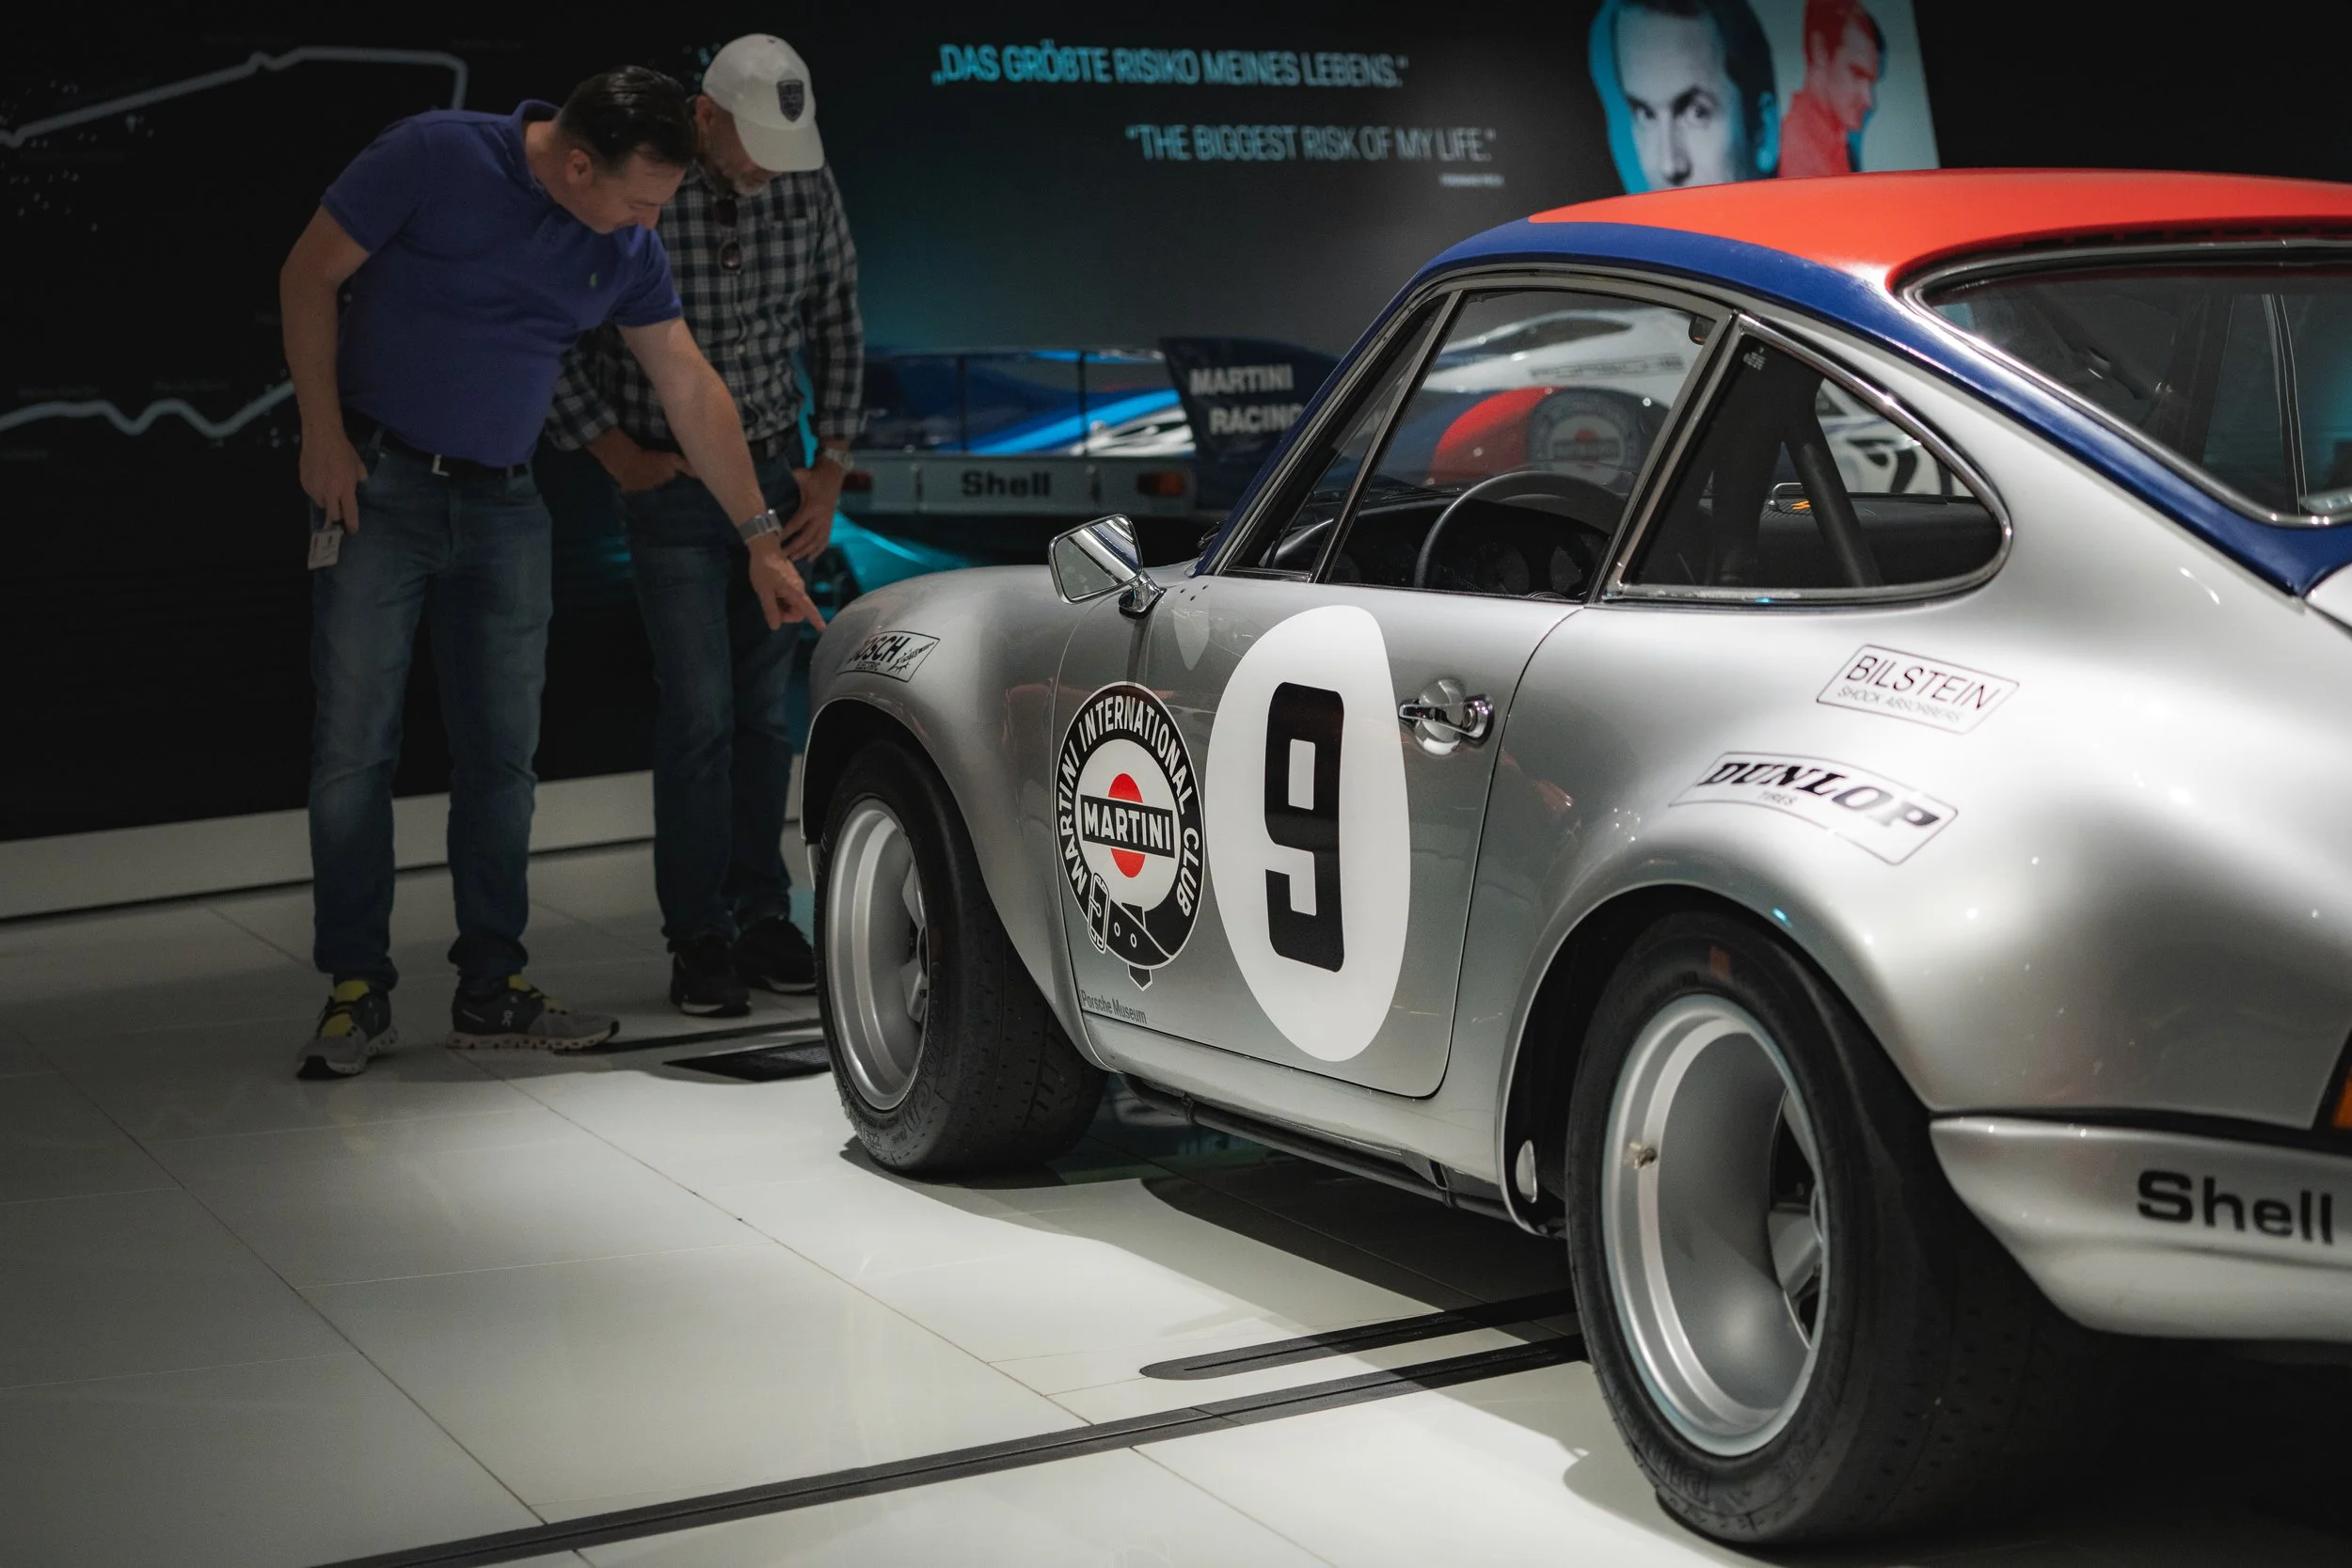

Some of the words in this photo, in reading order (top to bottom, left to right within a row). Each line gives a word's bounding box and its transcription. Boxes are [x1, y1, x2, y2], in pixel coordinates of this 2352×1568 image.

[1113, 47, 1200, 85] RISIKO
[1201, 49, 1301, 87] MEINES
[1192, 123, 1297, 162] BIGGEST
[1300, 125, 1359, 161] RISK
[1359, 126, 1393, 161] OF
[1394, 127, 1436, 161] MY
[1188, 364, 1294, 396] MARTINI
[961, 470, 1051, 498] Shell
[1846, 655, 2002, 711] BILSTEIN
[1059, 739, 1088, 896] MARTINI
[1078, 695, 1193, 816] INTERNATIONAL
[1176, 826, 1200, 917] CLUB
[1695, 762, 1940, 828] DUNLOP
[1083, 801, 1171, 850] MARTINI
[1264, 682, 1344, 973] 9
[1080, 989, 1113, 1014] Porsche
[1112, 997, 1148, 1024] Museum
[2137, 1169, 2333, 1245] Shell
